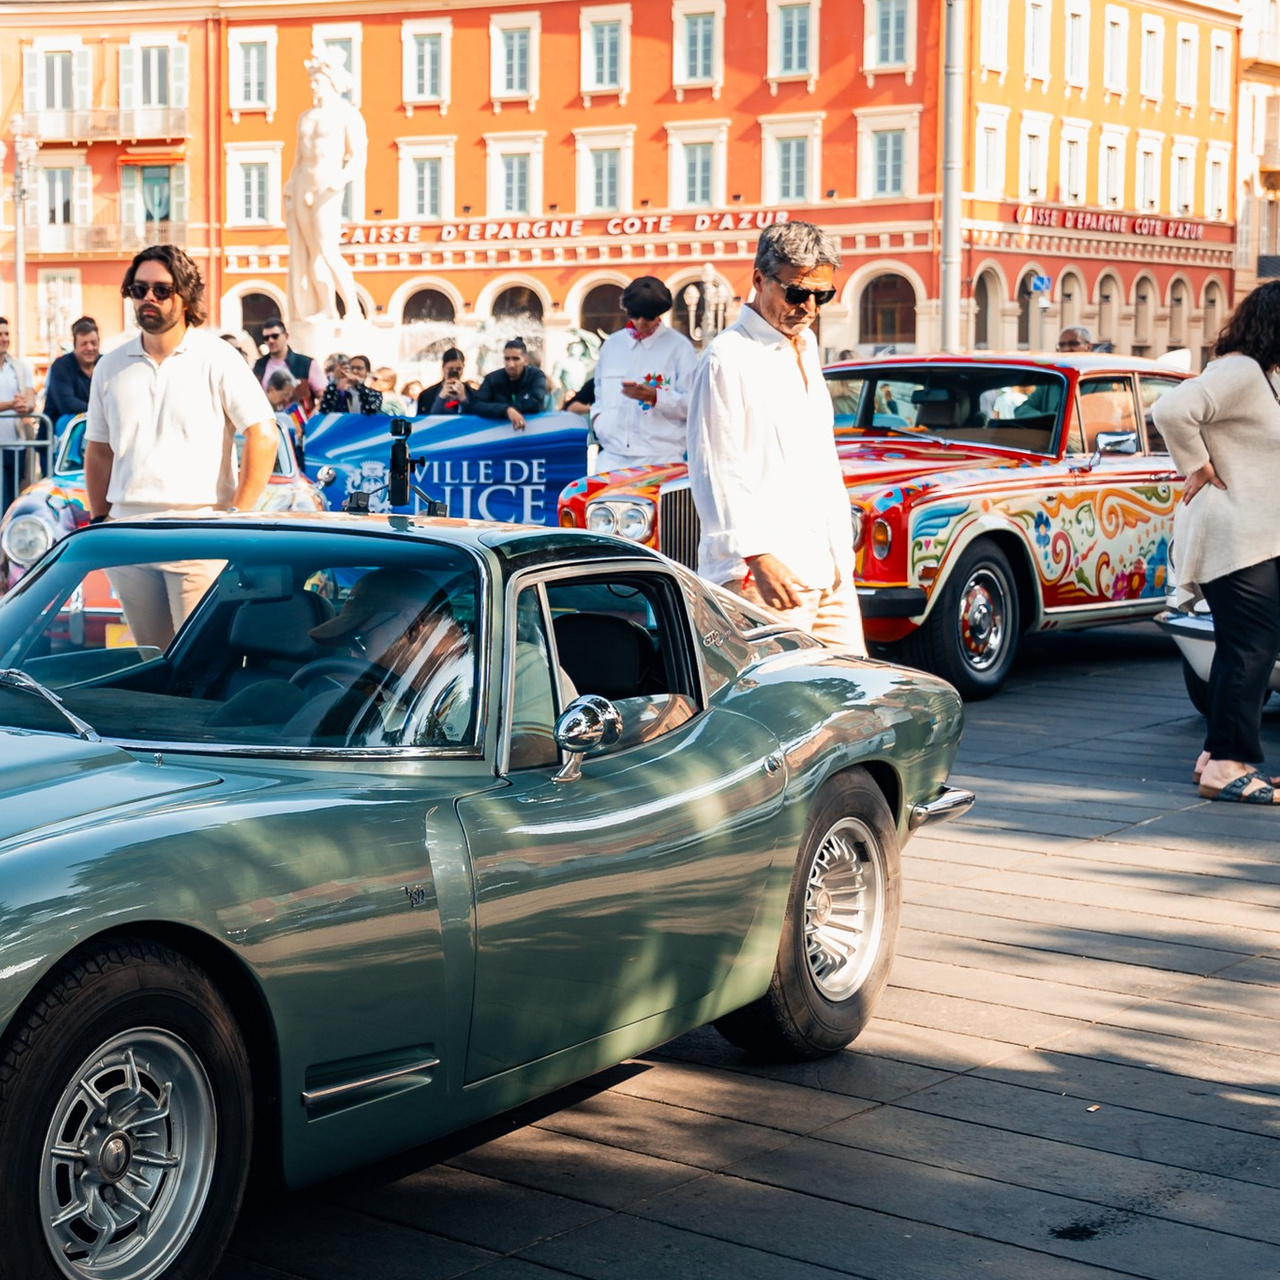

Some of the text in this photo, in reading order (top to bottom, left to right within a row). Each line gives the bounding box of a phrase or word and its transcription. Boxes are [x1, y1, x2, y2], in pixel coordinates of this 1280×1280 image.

[441, 220, 584, 241] D'EPARGNE
[607, 216, 673, 235] COTE
[694, 211, 790, 231] D'AZUR
[1065, 211, 1127, 233] D'EPARGNE
[1134, 218, 1162, 236] COTE
[1167, 223, 1205, 240] D'AZUR
[415, 459, 547, 483] VILLE DE
